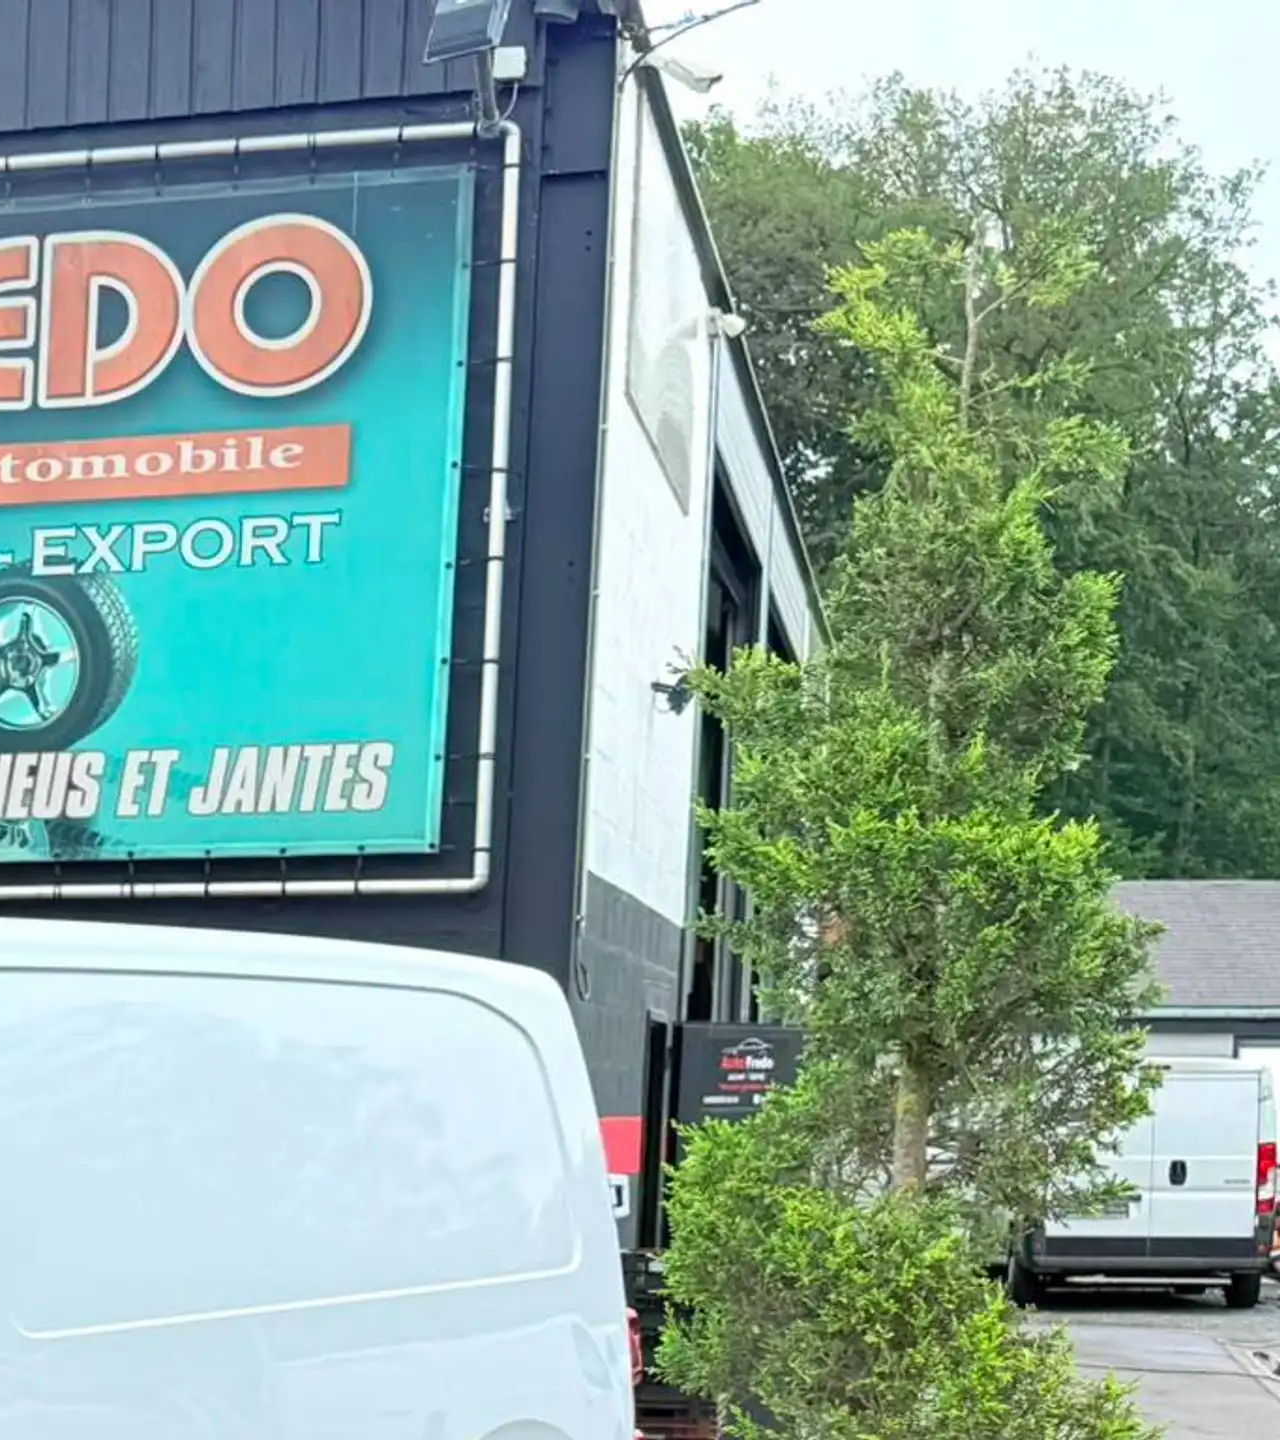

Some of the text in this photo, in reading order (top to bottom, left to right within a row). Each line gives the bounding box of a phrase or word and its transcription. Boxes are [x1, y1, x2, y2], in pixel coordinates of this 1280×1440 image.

[29, 510, 342, 577] EXPORT
[115, 748, 181, 818] ET
[187, 741, 395, 817] JANTES
